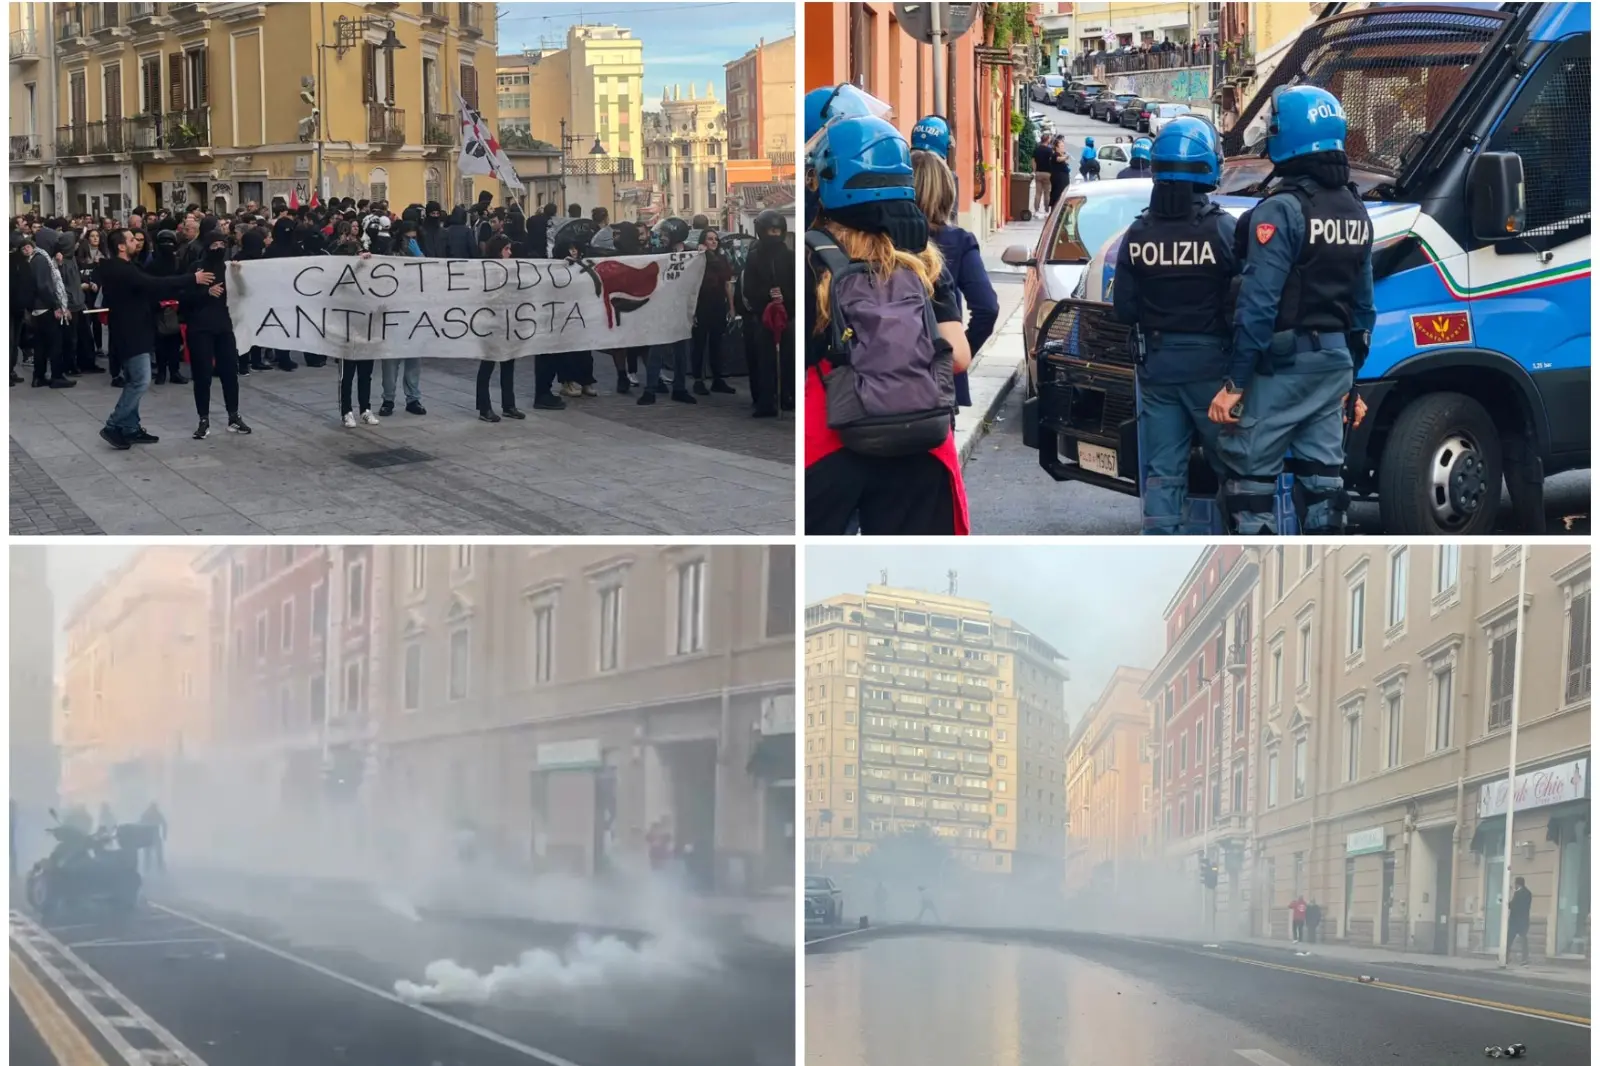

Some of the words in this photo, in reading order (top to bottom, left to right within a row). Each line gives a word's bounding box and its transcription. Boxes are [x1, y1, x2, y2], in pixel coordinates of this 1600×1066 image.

[1310, 218, 1369, 245] POLIZIA
[1129, 241, 1216, 266] POLIZIA
[255, 302, 585, 342] ANTIFASCISTA
[1533, 770, 1564, 799] Chic
